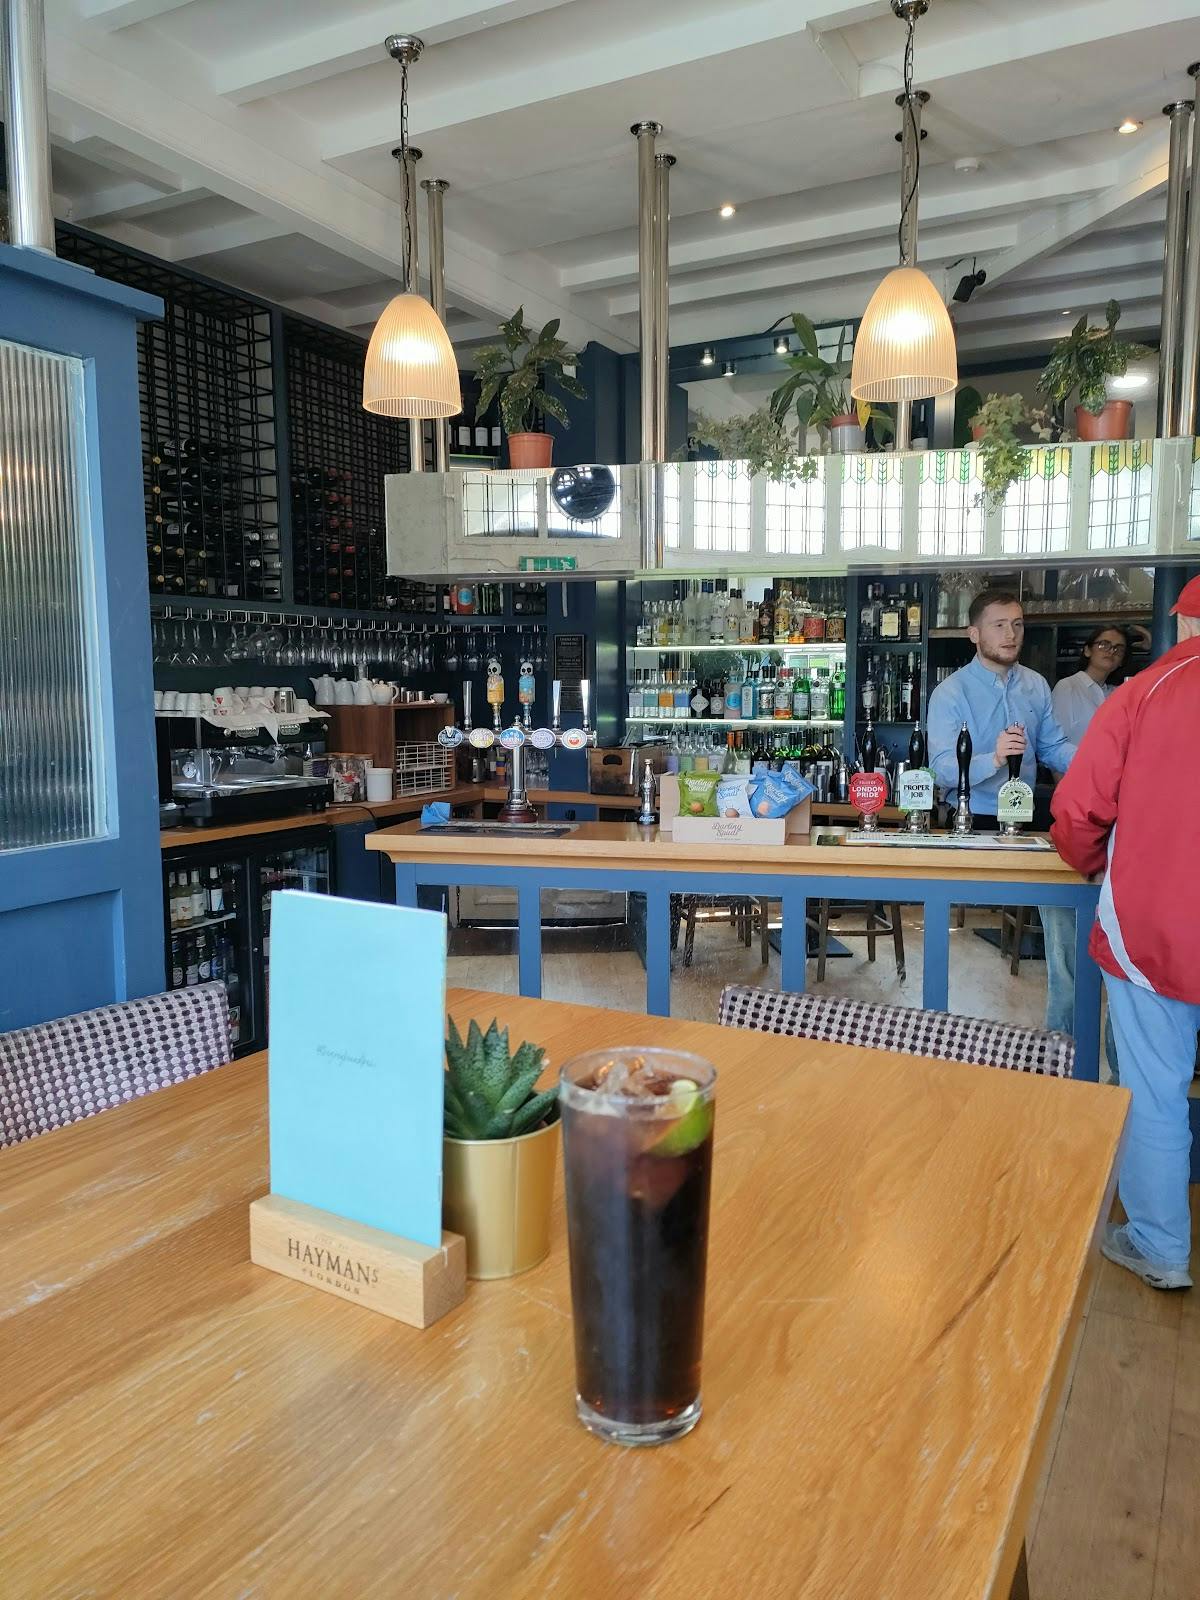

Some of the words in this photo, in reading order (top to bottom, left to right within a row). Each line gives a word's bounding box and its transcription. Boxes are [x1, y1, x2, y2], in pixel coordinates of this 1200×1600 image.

[910, 791, 924, 799] JOB
[711, 822, 744, 832] Darling
[309, 1270, 361, 1296] LONDON
